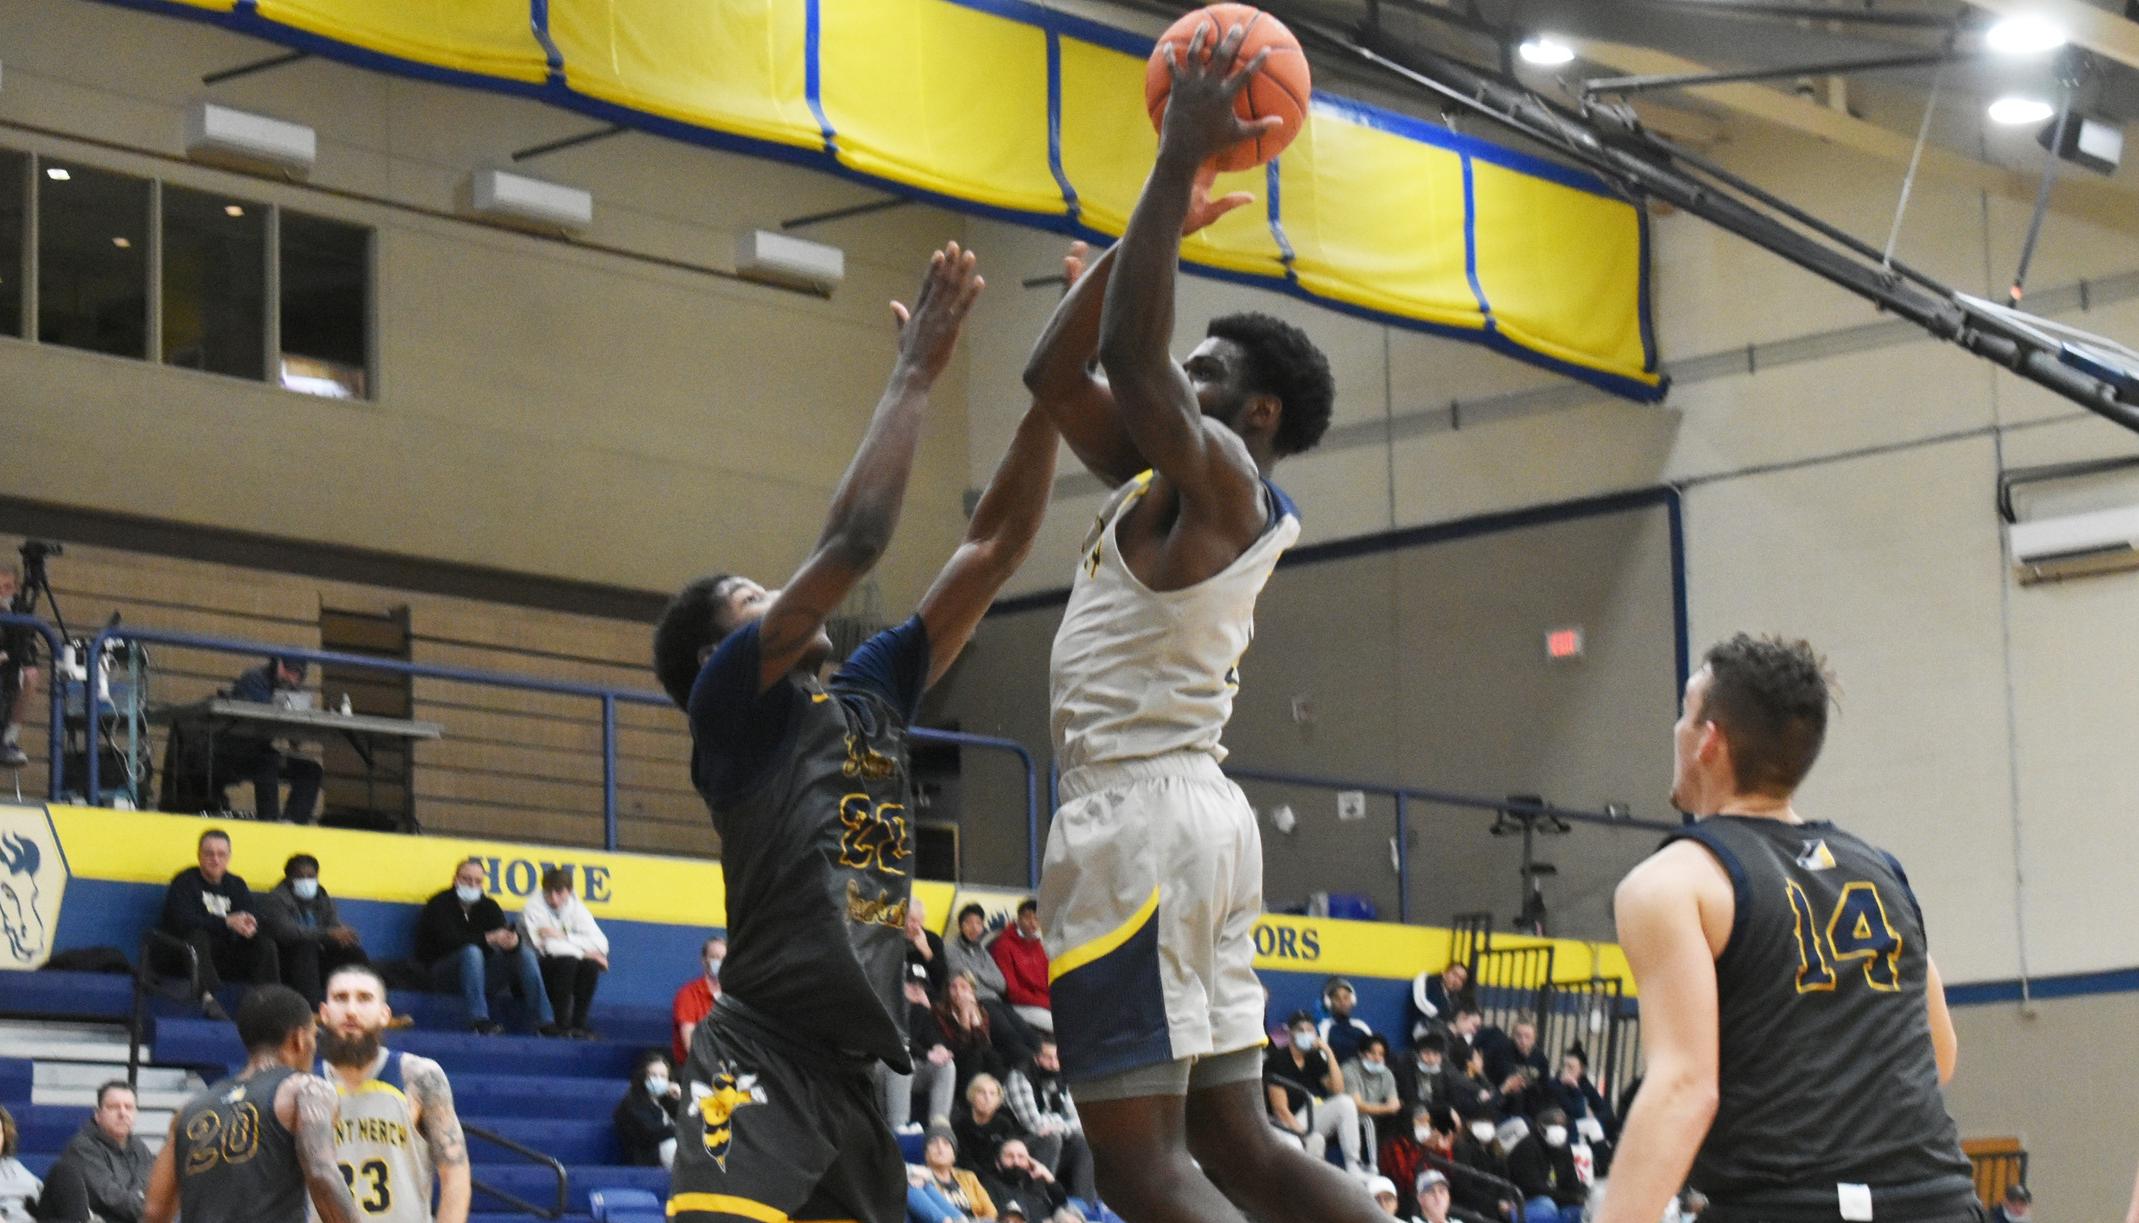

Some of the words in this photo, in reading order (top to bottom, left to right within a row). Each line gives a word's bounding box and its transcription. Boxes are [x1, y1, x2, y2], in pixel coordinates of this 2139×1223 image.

[1253, 924, 1320, 961] ORS
[1785, 877, 1903, 993] 14
[186, 1101, 260, 1176] 20
